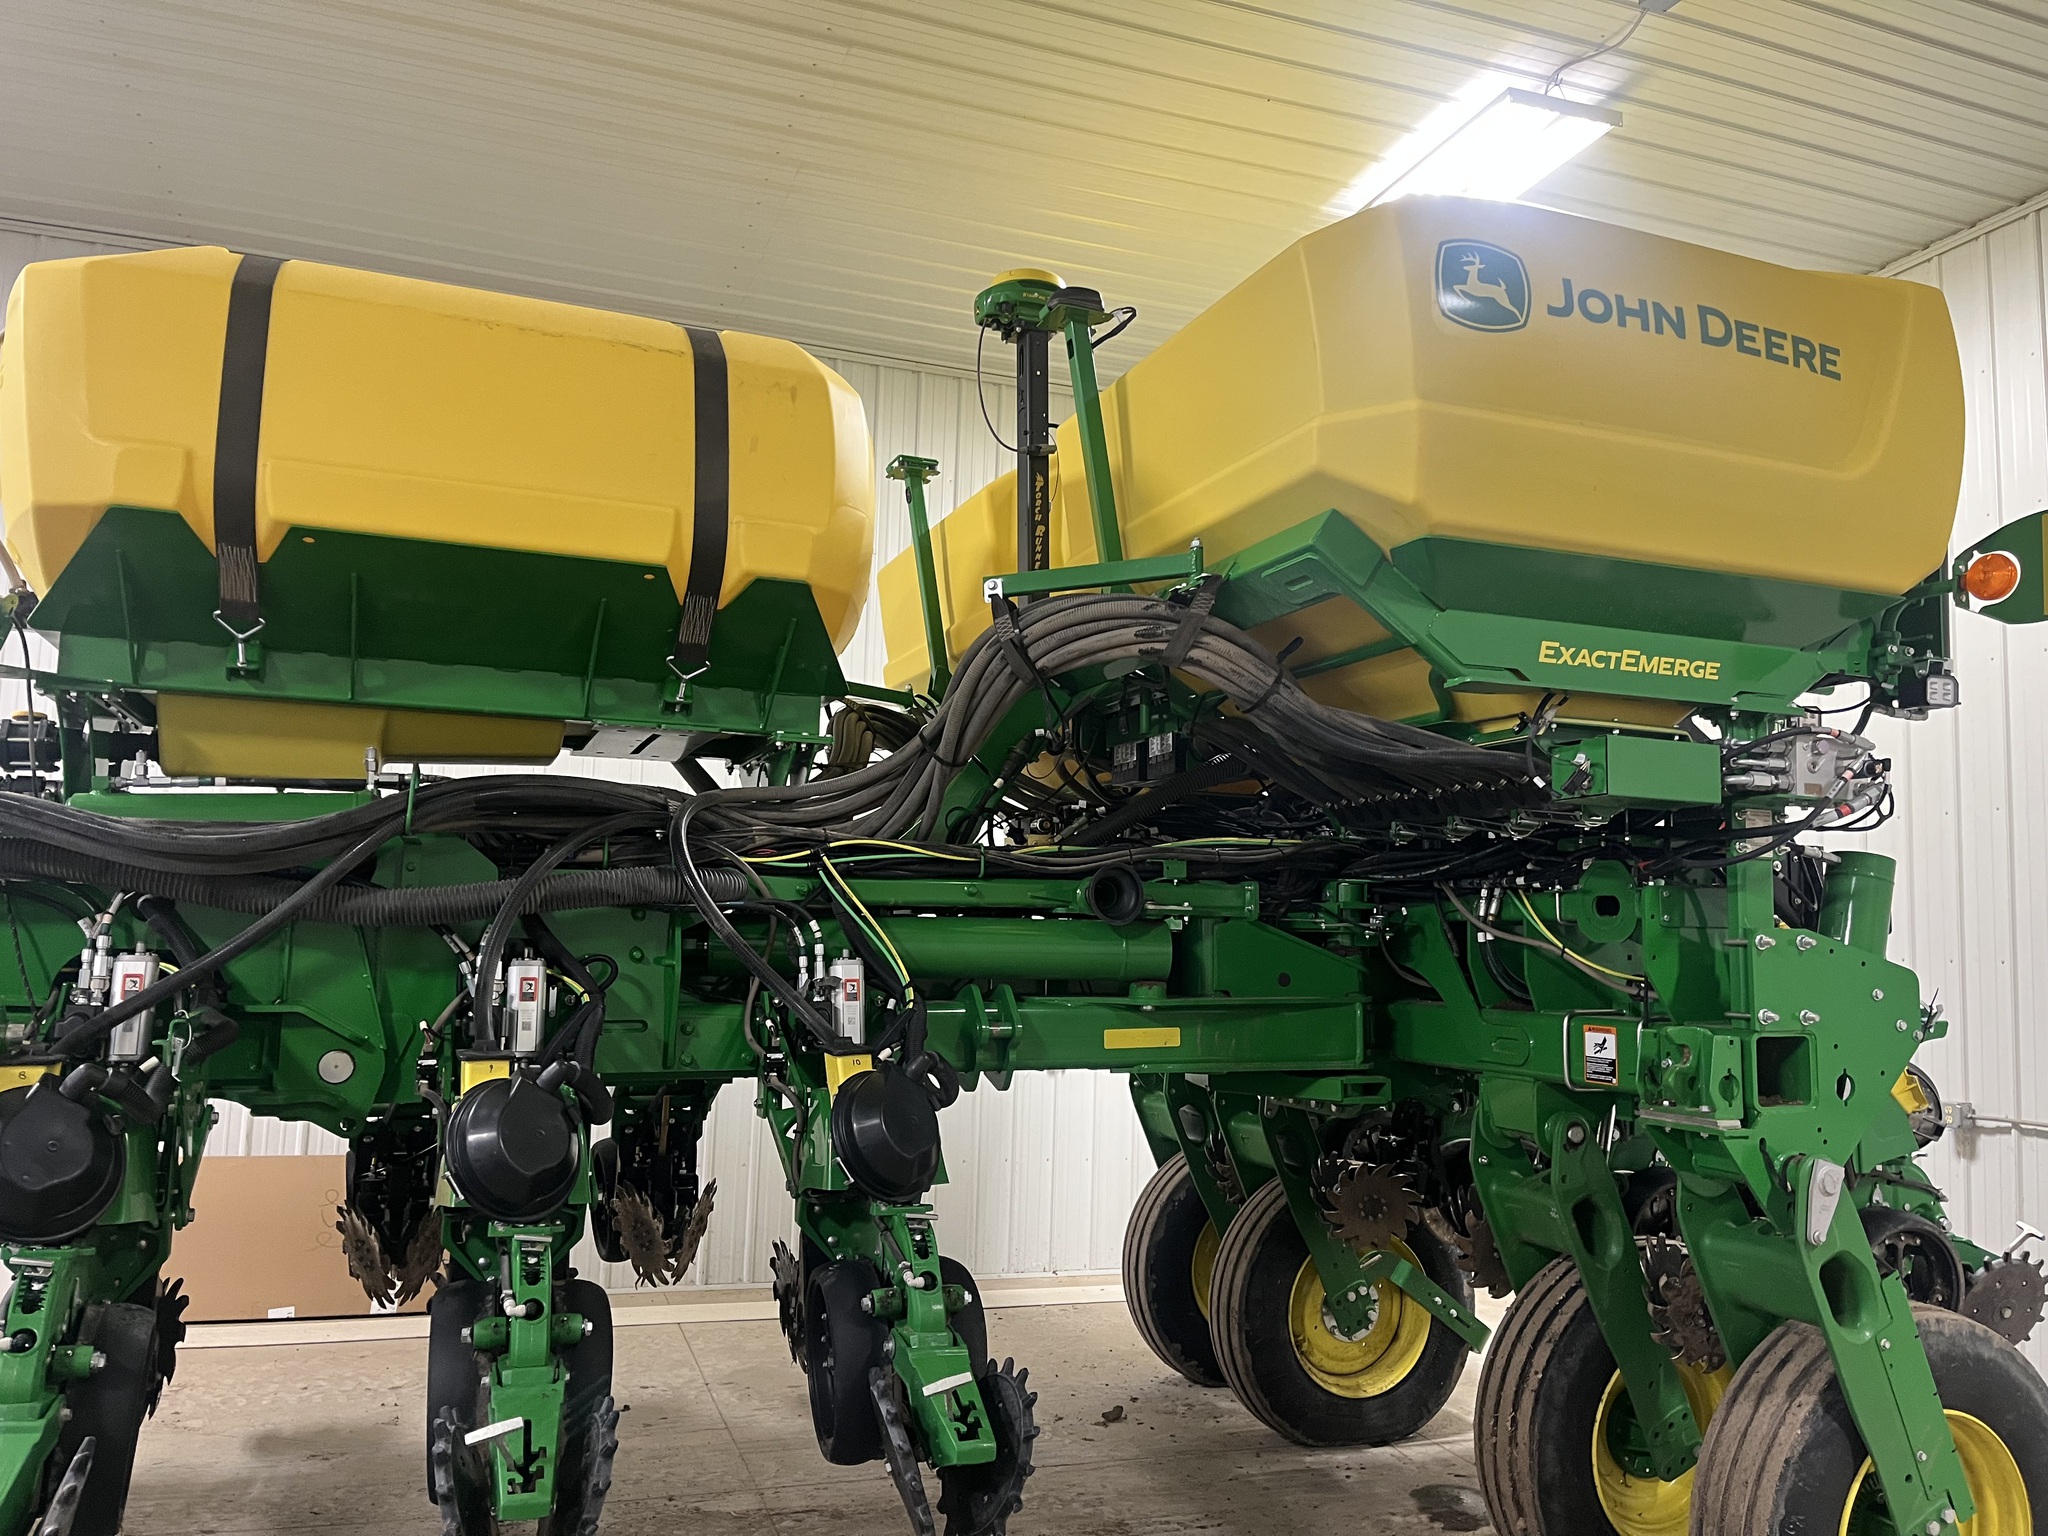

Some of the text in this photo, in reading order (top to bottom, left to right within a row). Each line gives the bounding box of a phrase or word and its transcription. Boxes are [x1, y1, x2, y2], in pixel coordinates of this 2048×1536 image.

[1547, 278, 1841, 381] JOHN DEERE
[1034, 472, 1046, 570] TORCH RUNNE
[1538, 640, 1721, 680] EXACTEMERGE
[18, 1070, 27, 1080] 8
